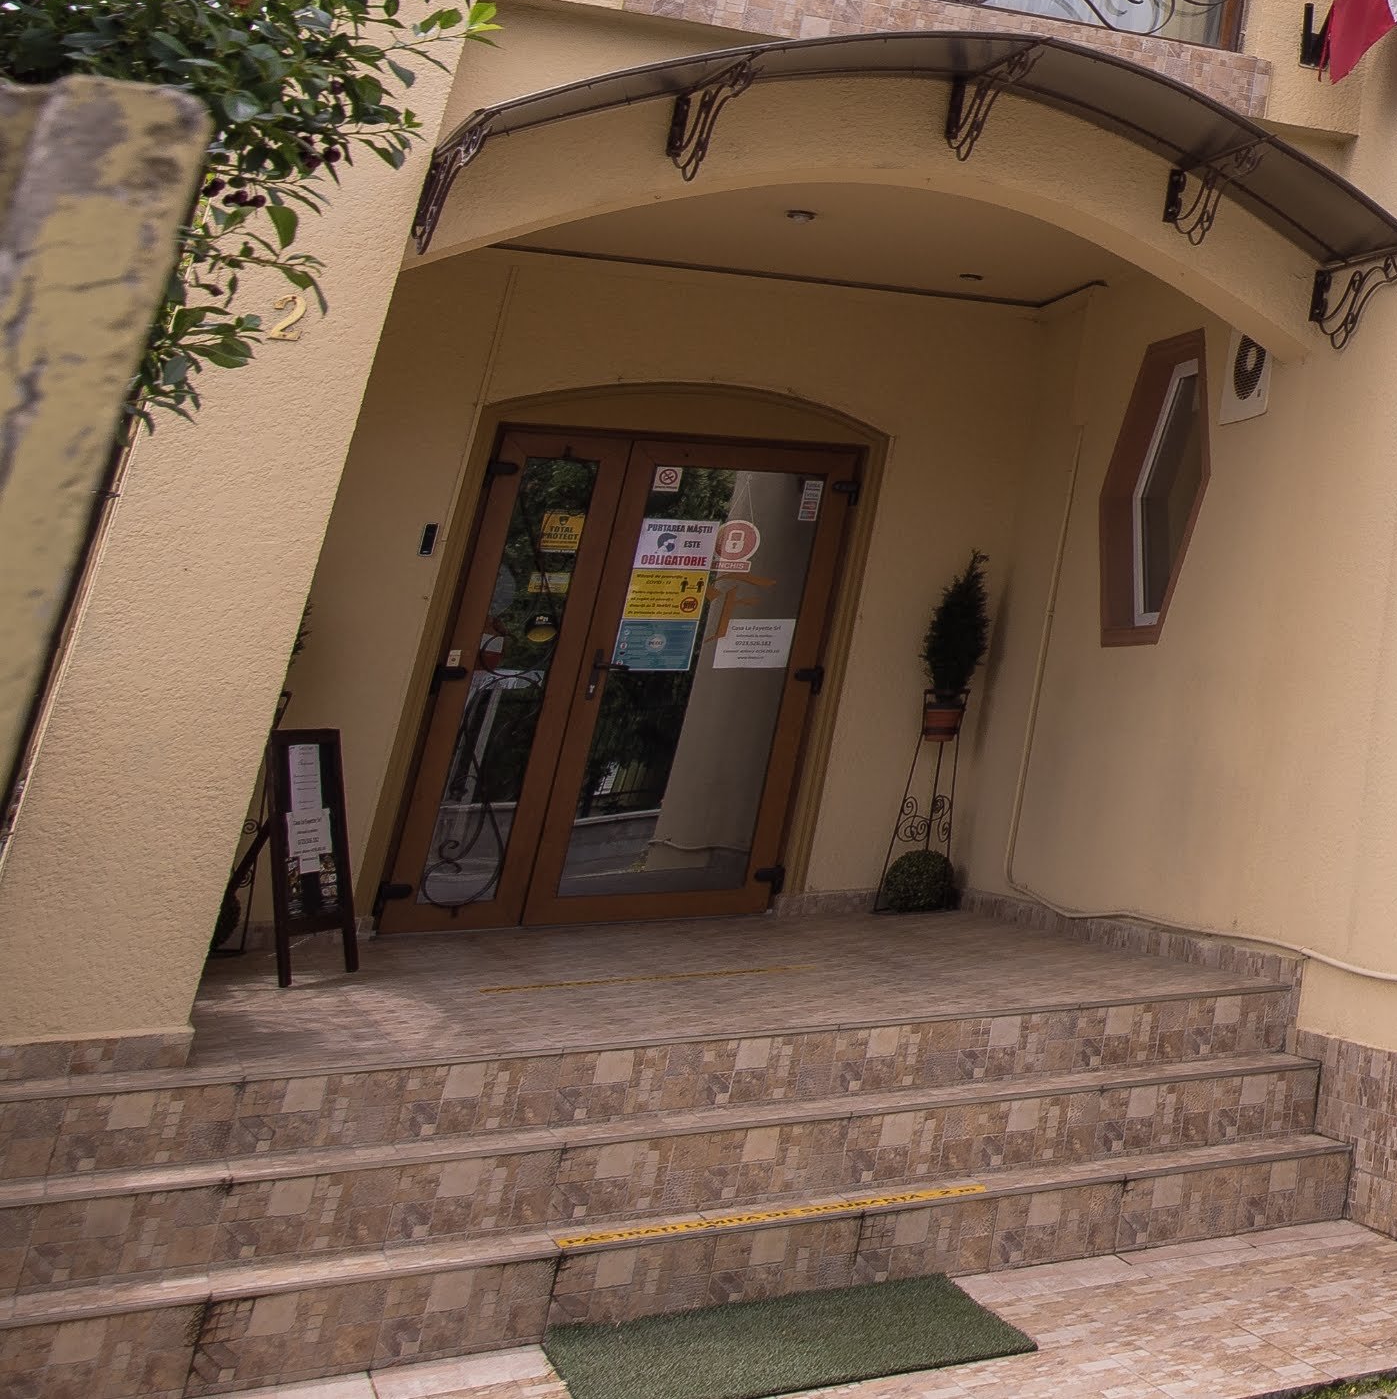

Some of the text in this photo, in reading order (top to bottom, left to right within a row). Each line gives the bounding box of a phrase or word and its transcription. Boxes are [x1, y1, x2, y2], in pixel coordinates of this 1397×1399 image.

[267, 293, 309, 342] 2
[549, 525, 574, 533] TOTAL
[647, 523, 686, 533] PURTAREA
[683, 540, 702, 549] ESTE
[640, 554, 708, 567] OBLIGATORIE
